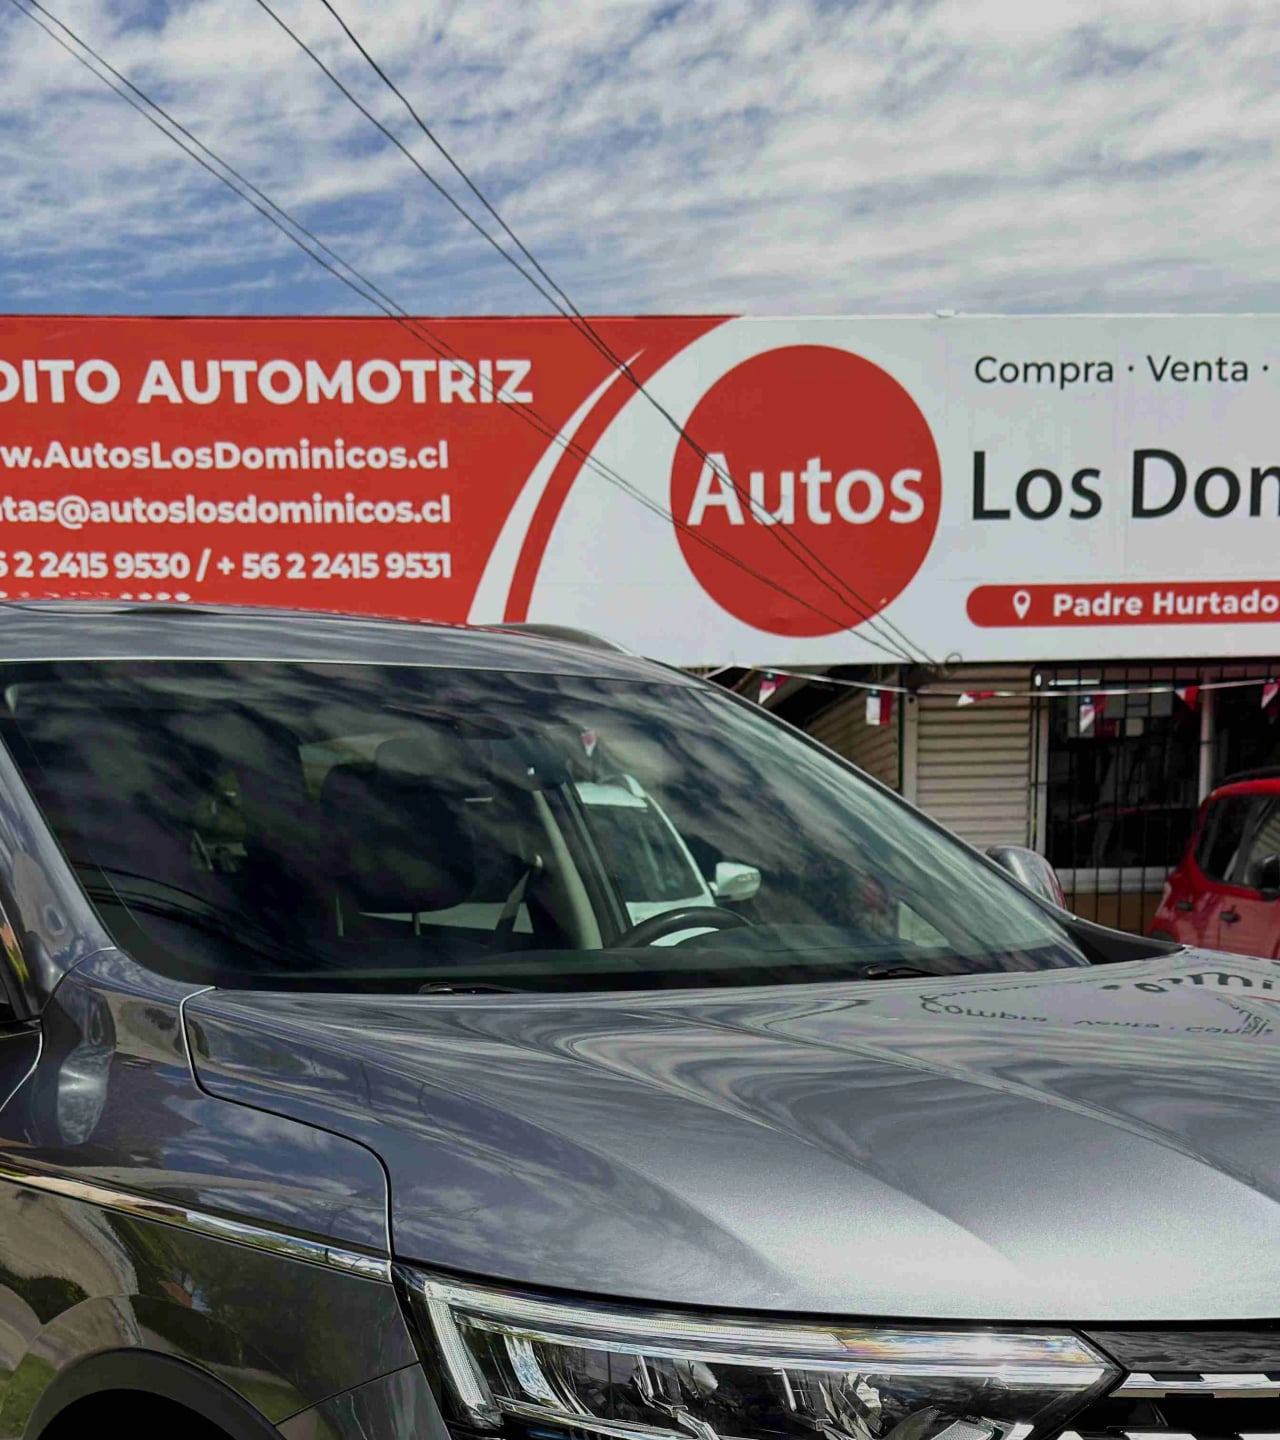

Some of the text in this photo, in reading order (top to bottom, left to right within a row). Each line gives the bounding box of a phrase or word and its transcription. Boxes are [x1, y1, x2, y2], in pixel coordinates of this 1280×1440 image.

[138, 359, 533, 405] AUTOMOTRIZ
[974, 356, 1114, 389] Compra
[1146, 355, 1248, 382] Venta
[687, 452, 925, 526] Autos
[972, 450, 1102, 521] Los
[14, 550, 35, 578] 2
[39, 551, 109, 579] 2415
[113, 552, 191, 579] 9530
[242, 552, 281, 580] 56
[286, 552, 307, 579] 2
[312, 552, 380, 579] 2415
[384, 552, 451, 579] 9531
[1053, 591, 1143, 617] Padre
[1152, 589, 1280, 615] Hurtado
